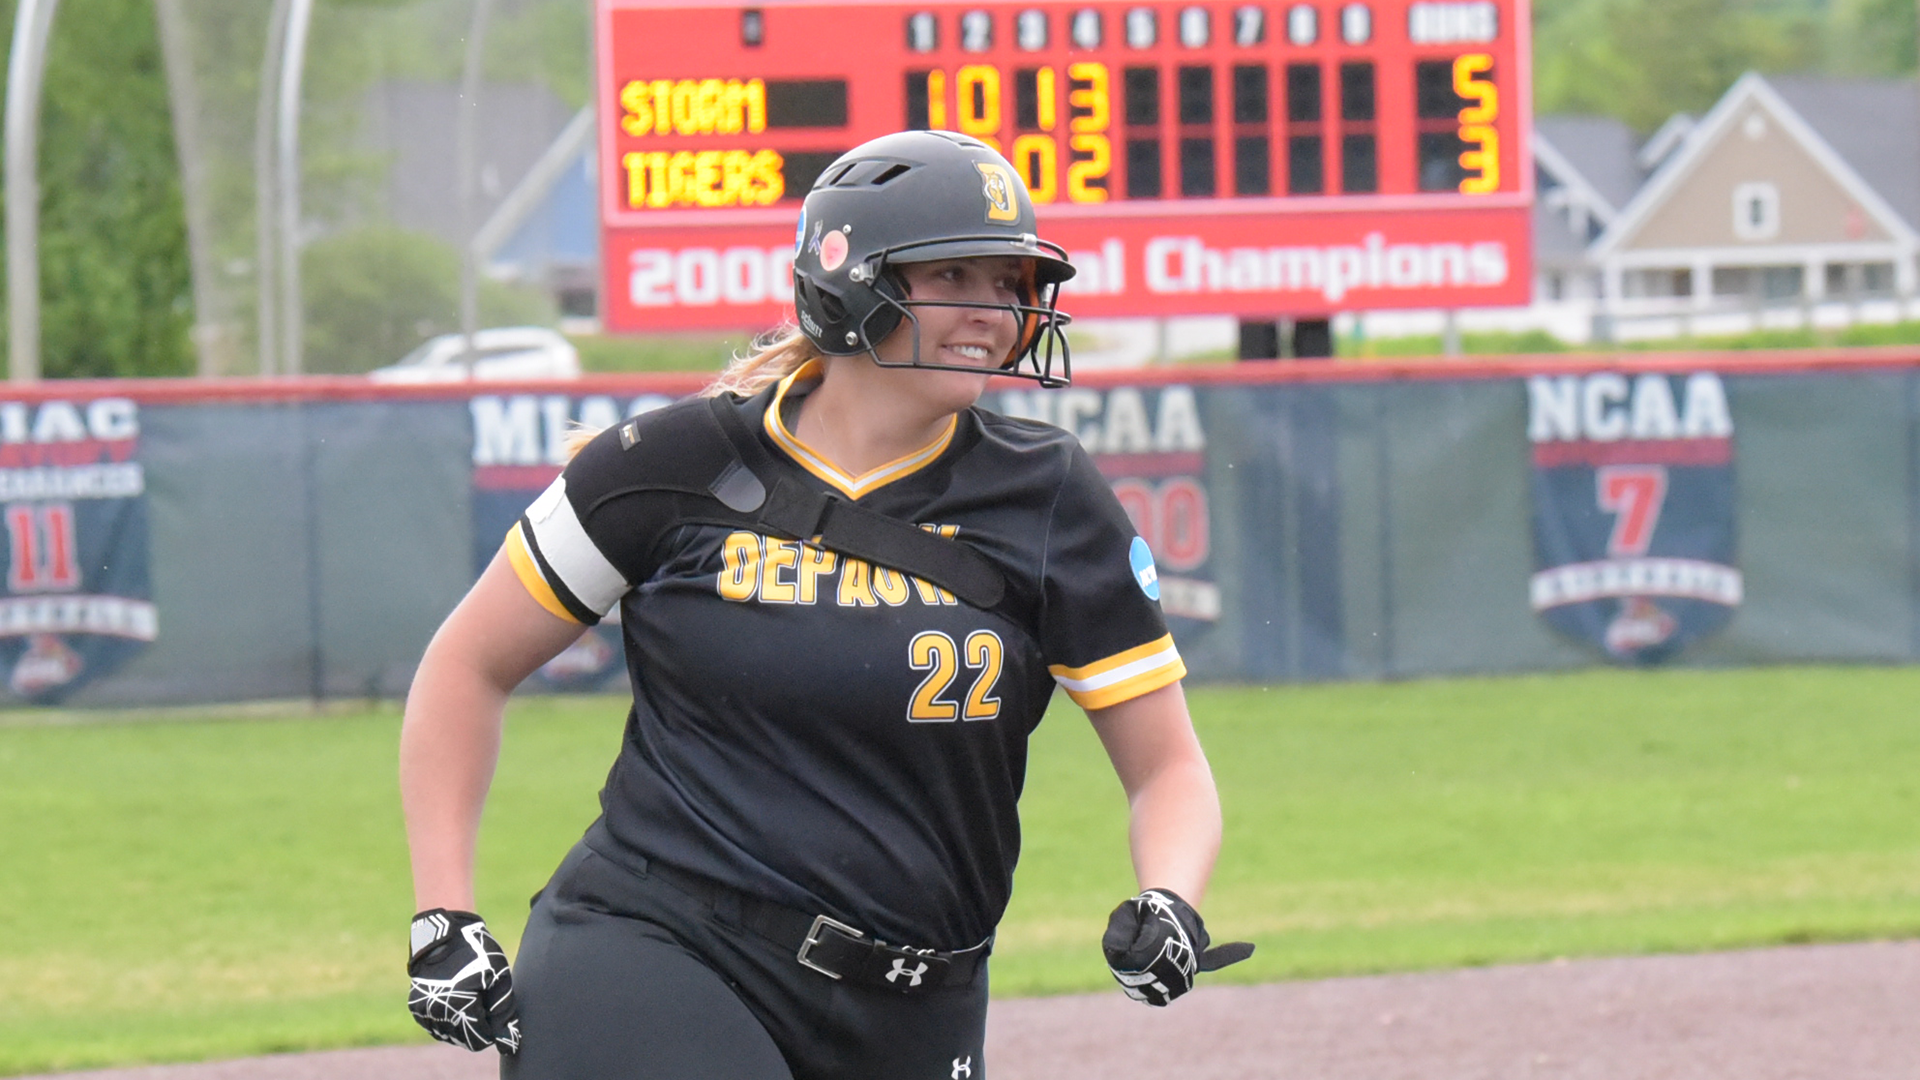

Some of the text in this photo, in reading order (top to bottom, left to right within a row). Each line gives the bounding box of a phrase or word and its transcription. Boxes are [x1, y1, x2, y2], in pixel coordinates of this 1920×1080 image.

[620, 78, 766, 136] STORM
[1068, 62, 1110, 133] 3
[623, 149, 785, 208] TIGERS
[1068, 133, 1111, 203] 2
[1459, 124, 1499, 194] 3
[1145, 232, 1508, 302] Champions
[1527, 372, 1734, 440] NCAA
[6, 503, 82, 592] 11
[1595, 466, 1668, 555] 7
[907, 630, 1004, 722] 22
